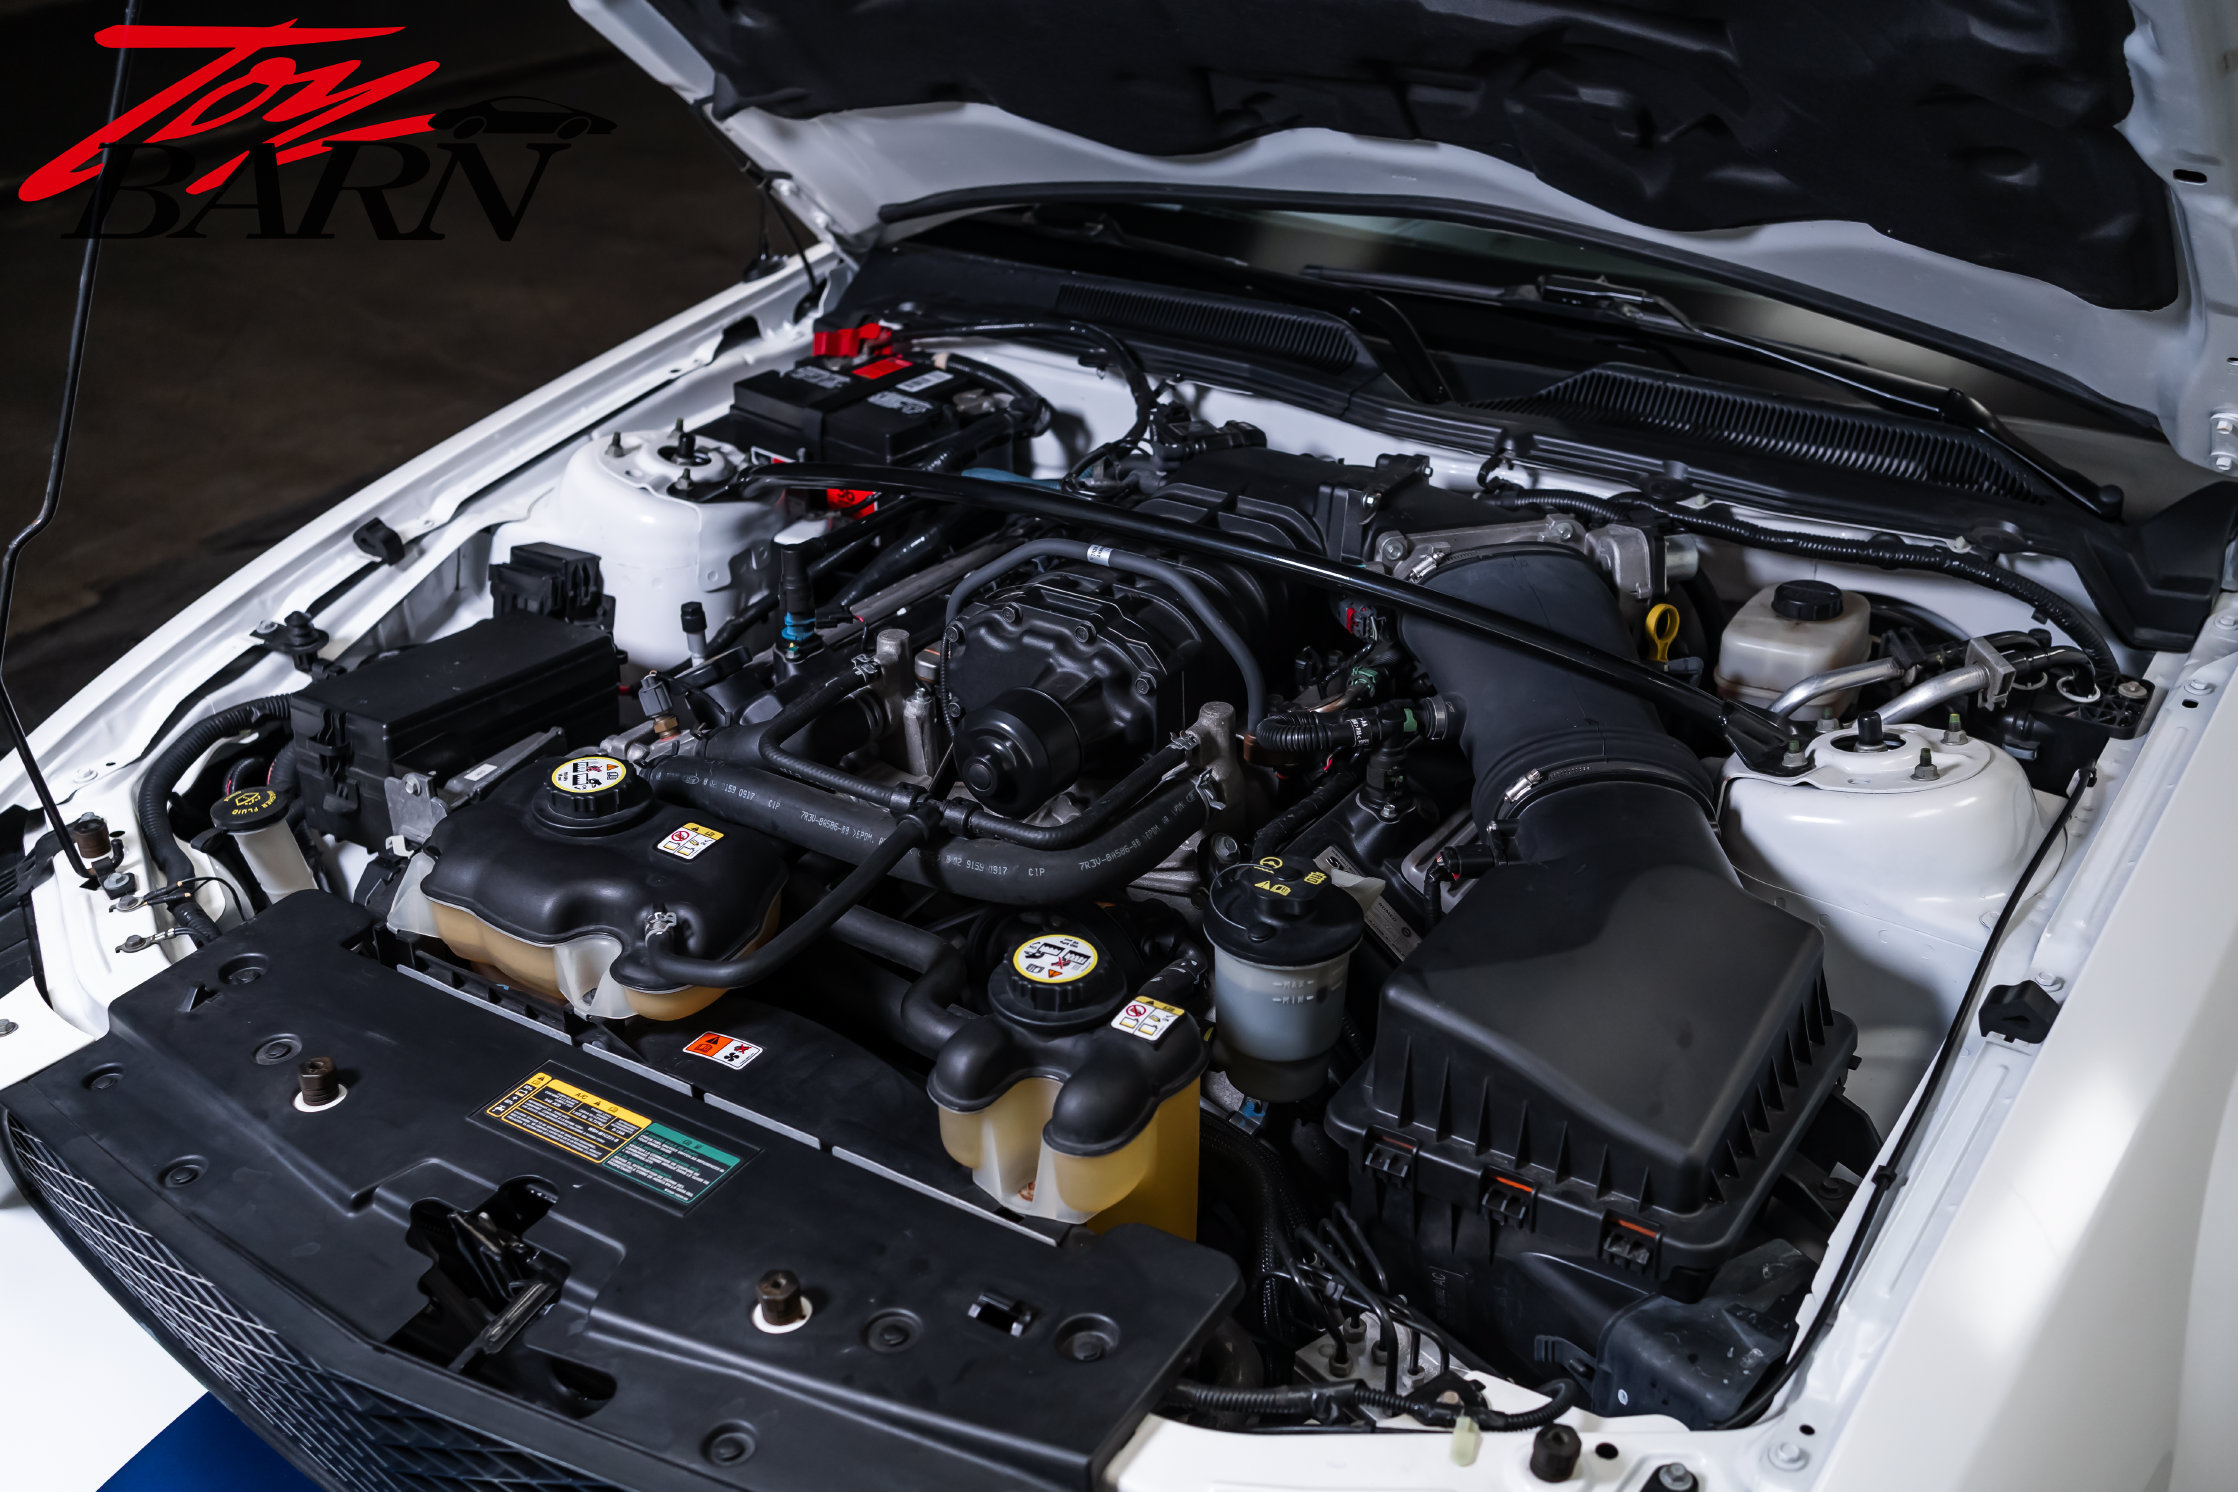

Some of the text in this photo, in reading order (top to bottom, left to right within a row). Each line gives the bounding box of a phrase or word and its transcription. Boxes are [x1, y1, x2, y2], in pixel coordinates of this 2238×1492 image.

[232, 806, 259, 815] FLUID
[1028, 868, 1046, 877] CIP
[1283, 980, 1304, 989] MAX
[1282, 995, 1304, 1005] MIN
